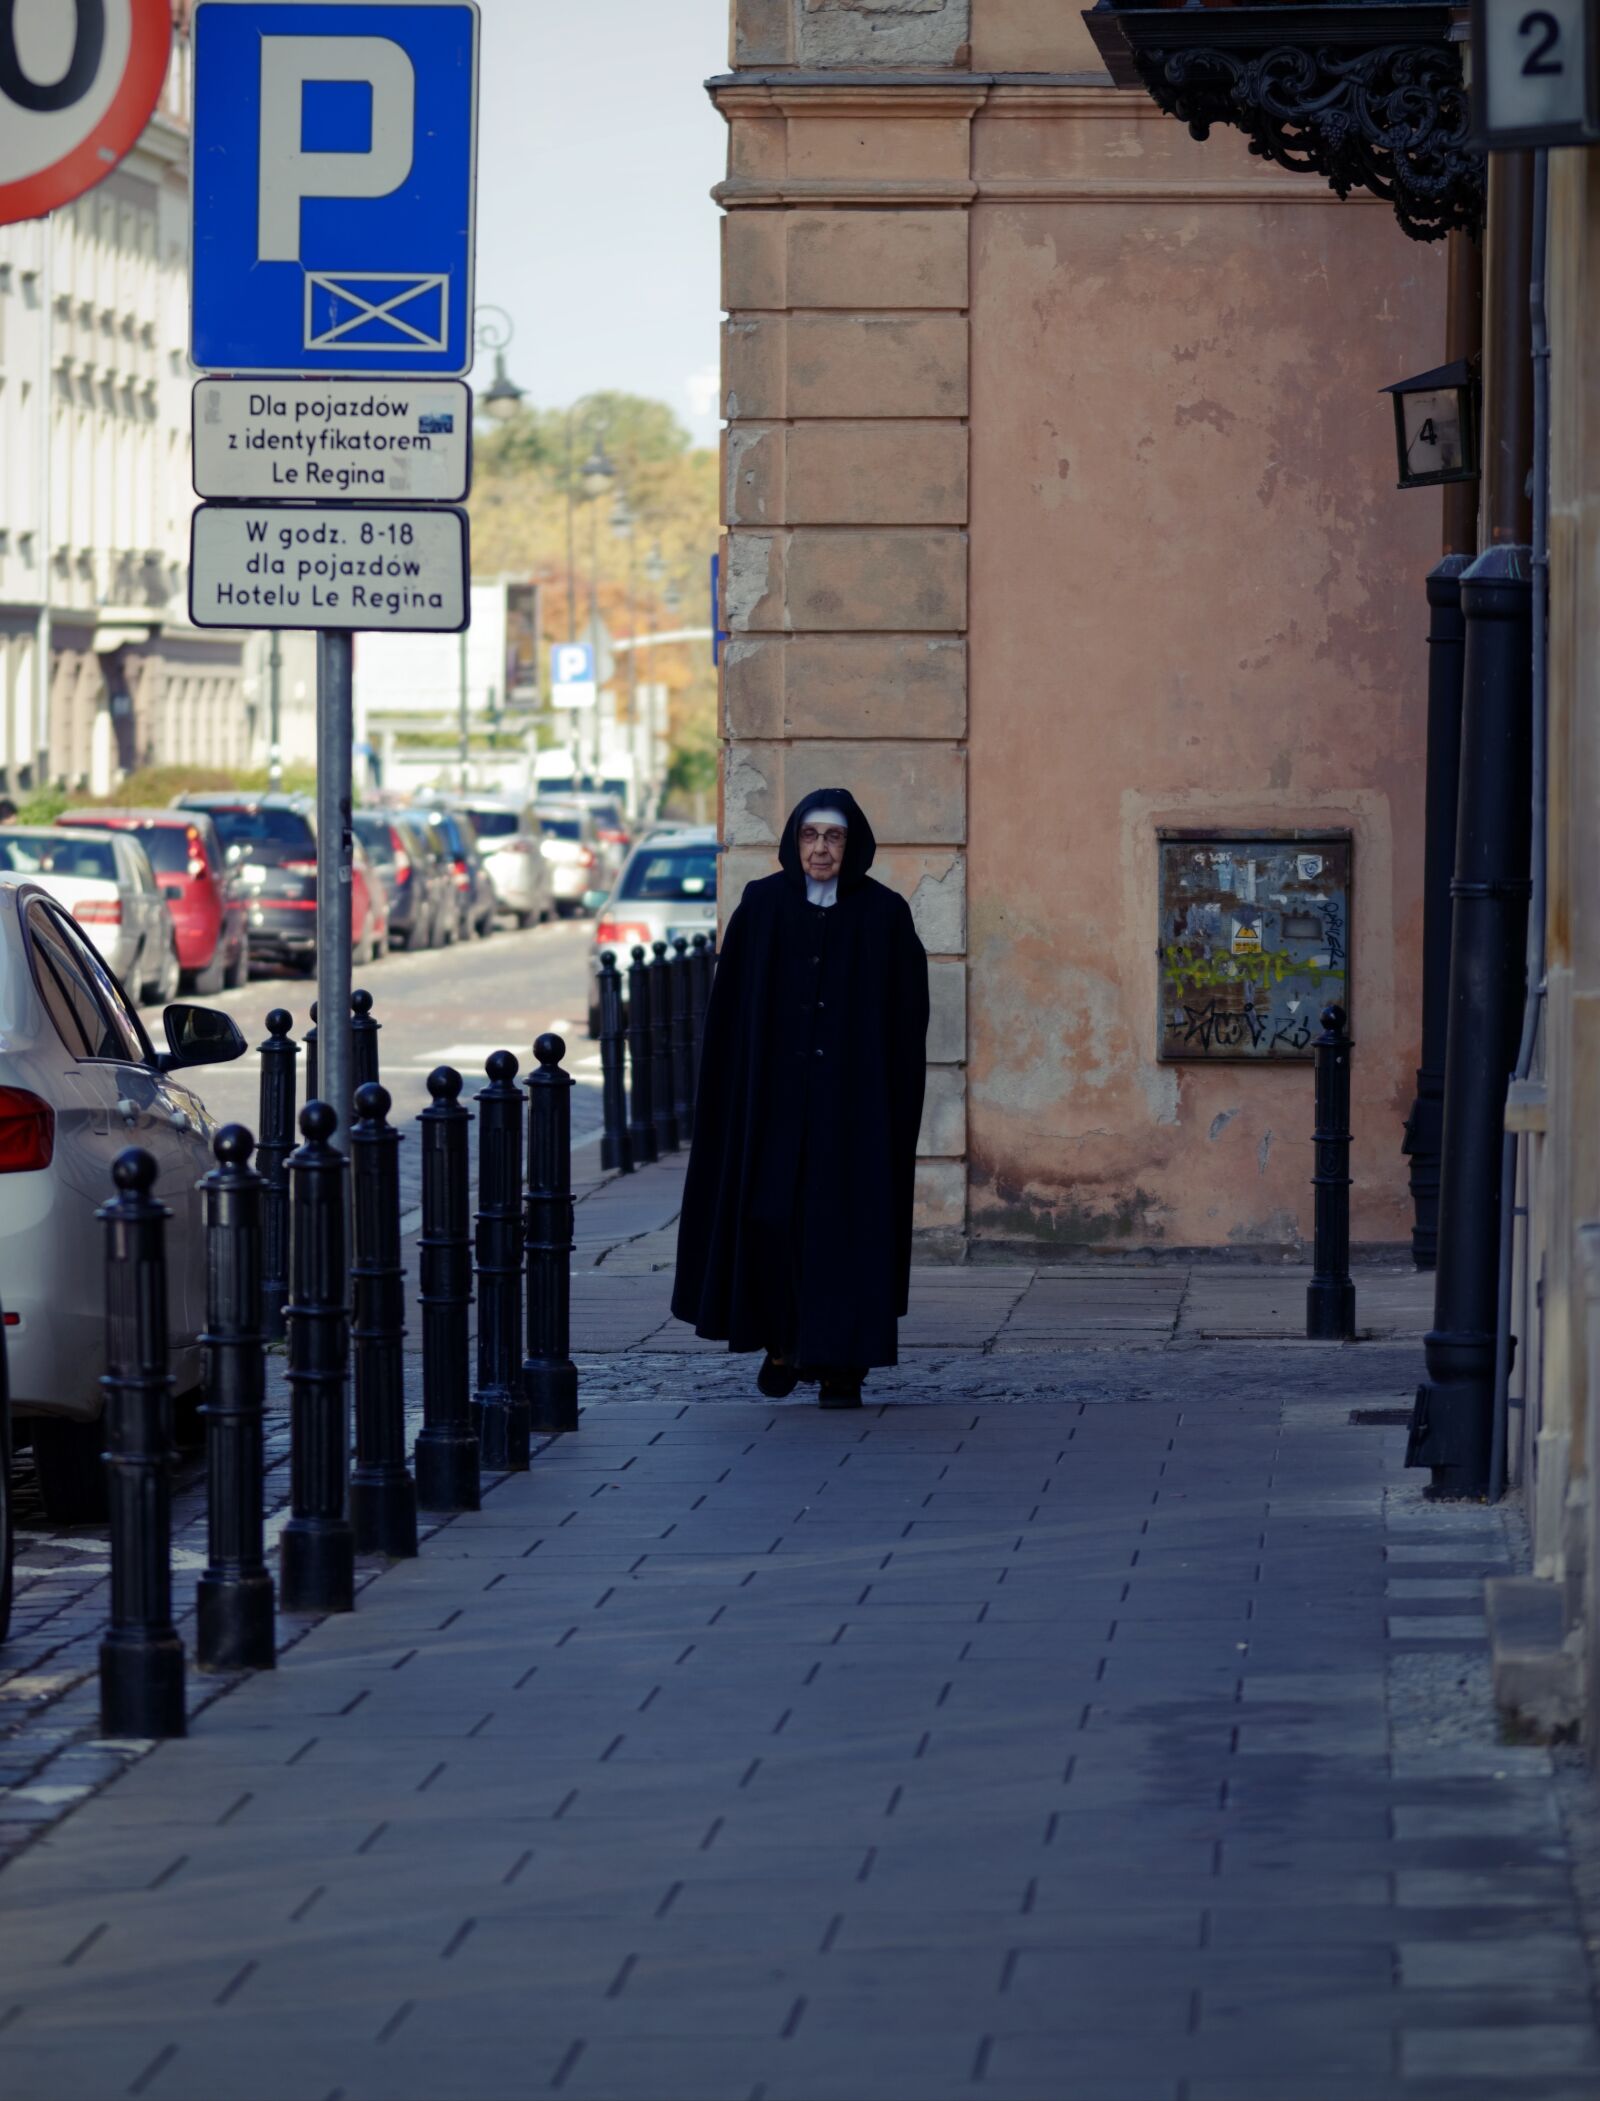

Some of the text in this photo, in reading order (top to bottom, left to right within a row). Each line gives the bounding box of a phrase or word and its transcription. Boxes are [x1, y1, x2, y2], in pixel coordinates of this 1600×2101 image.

[1518, 11, 1565, 77] 2
[257, 35, 415, 262] P
[250, 395, 408, 422] Dla pojazdów
[228, 428, 431, 456] z identyfikatorem
[1420, 418, 1438, 445] 4
[273, 462, 384, 490] Le Regina
[246, 521, 413, 549] W godz. 8-18
[247, 553, 420, 581] dla pojazdów
[217, 583, 442, 614] Hotelu Le Regina
[558, 647, 587, 682] P
